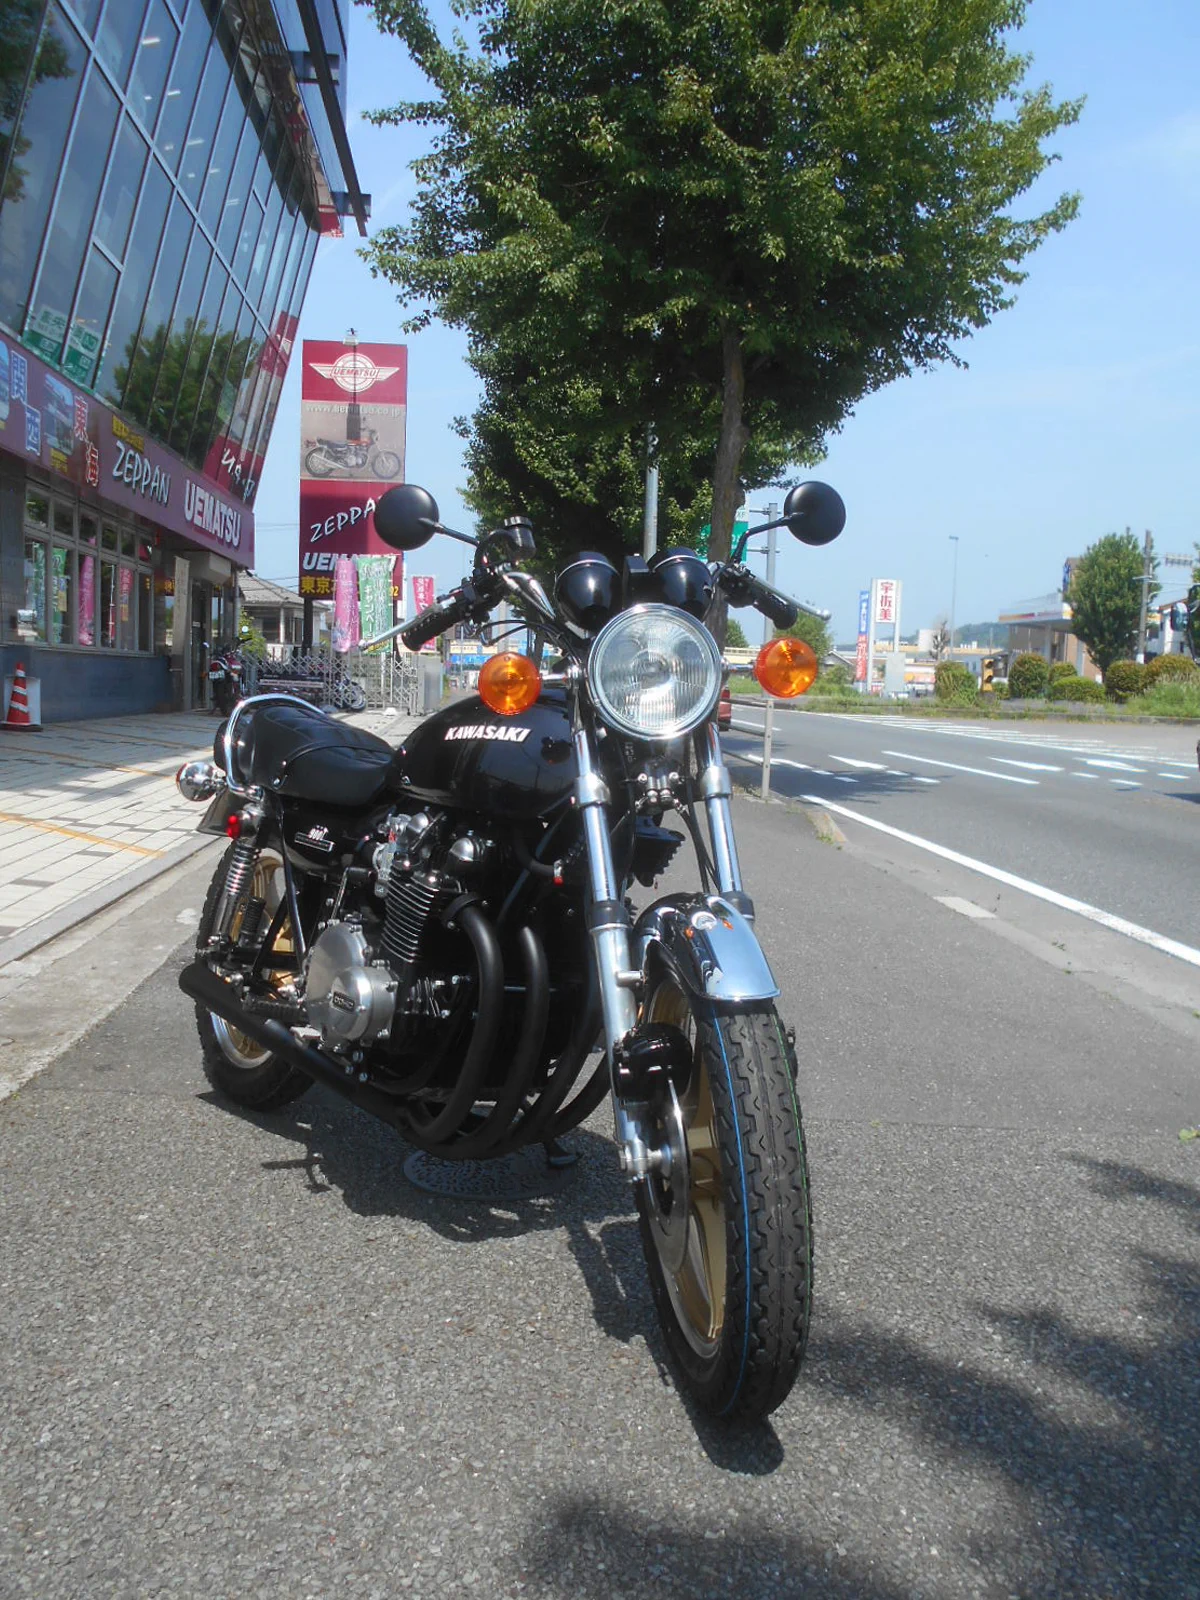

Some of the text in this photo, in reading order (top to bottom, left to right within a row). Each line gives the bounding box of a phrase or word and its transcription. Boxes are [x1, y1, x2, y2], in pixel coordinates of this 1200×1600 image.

[333, 367, 377, 378] UEMATSU
[112, 440, 171, 504] ZEPPAN
[184, 480, 241, 547] UEMATSU
[310, 495, 383, 542] ZEPPA
[301, 575, 336, 594] 東京
[880, 581, 894, 621] 宇佐美
[444, 725, 532, 743] KAWASAKI
